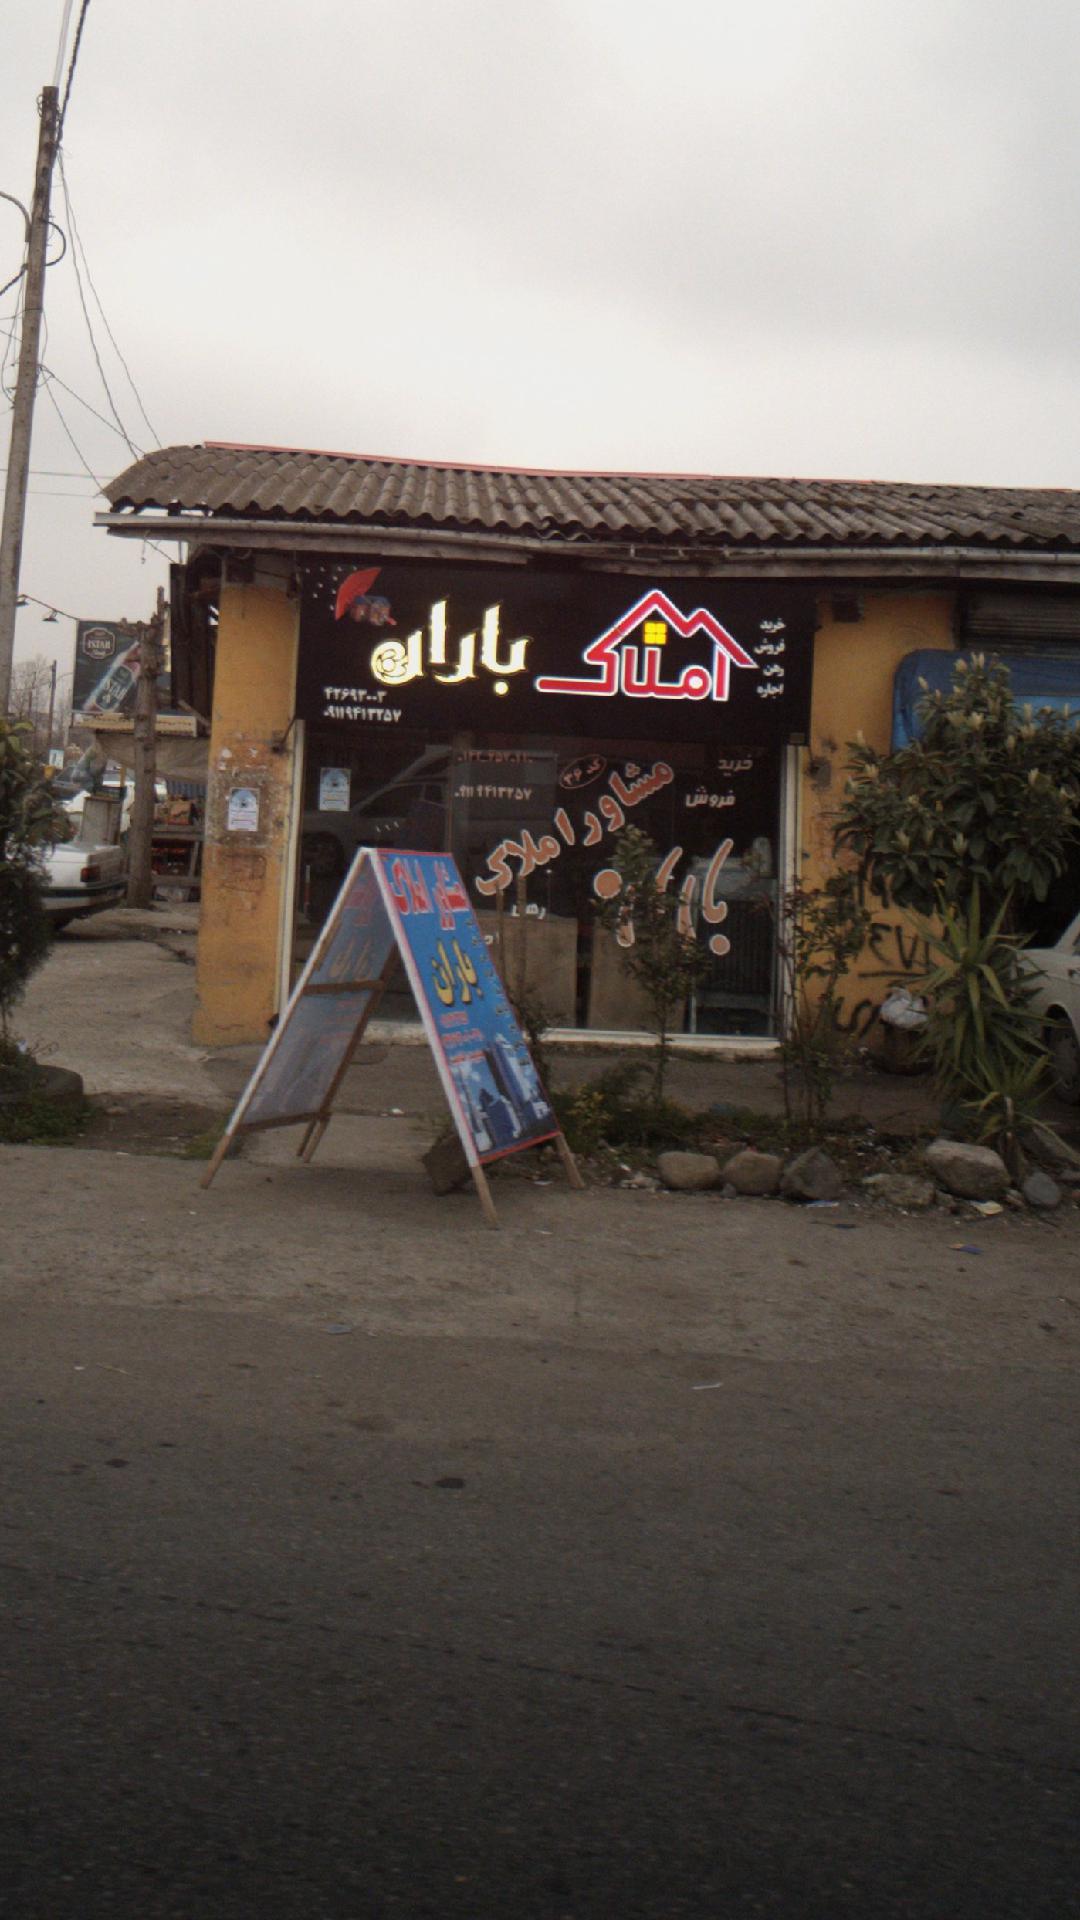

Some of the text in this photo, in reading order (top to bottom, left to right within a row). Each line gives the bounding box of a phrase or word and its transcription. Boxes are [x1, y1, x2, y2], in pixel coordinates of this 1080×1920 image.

[759, 617, 787, 633] خرید
[370, 599, 530, 696] باران
[753, 637, 786, 656] فروش
[763, 663, 785, 677] رهن
[756, 682, 785, 700] اجاره
[717, 754, 754, 777] خرید
[685, 785, 737, 809] فروش
